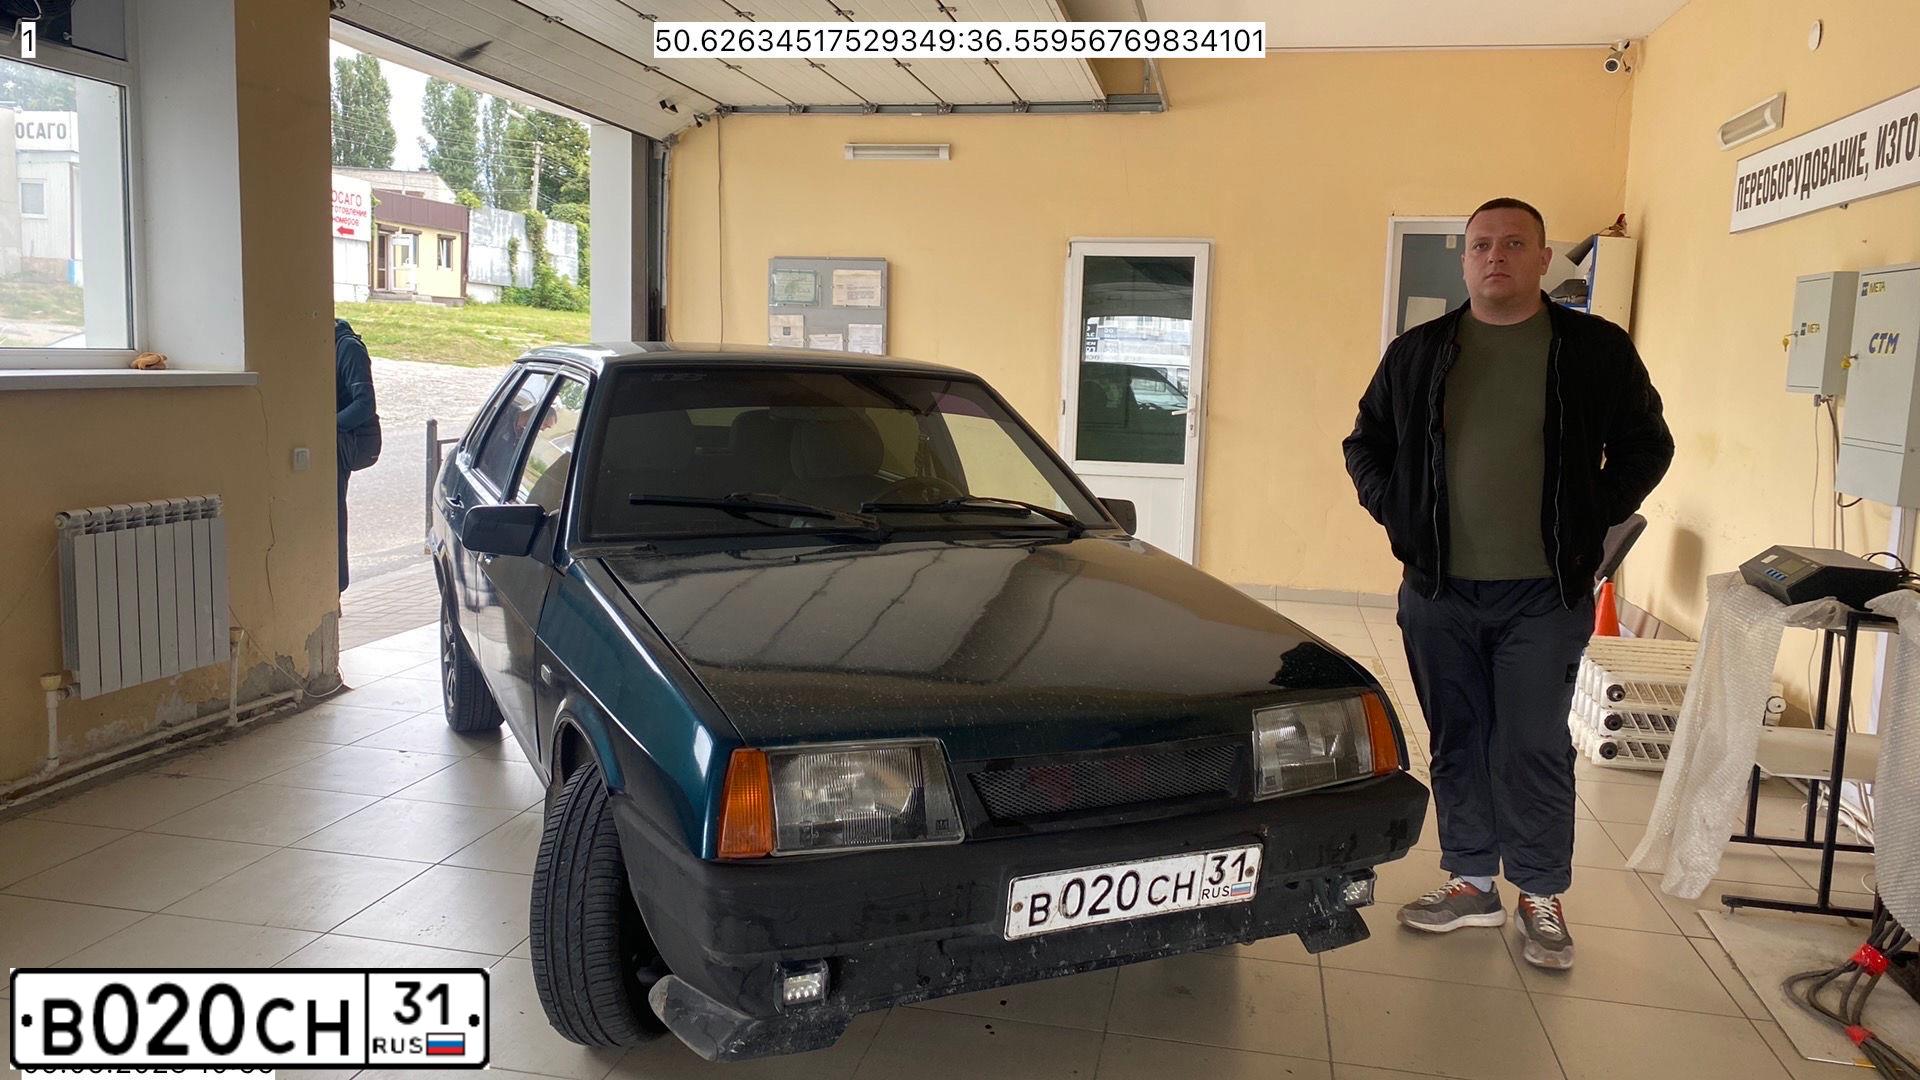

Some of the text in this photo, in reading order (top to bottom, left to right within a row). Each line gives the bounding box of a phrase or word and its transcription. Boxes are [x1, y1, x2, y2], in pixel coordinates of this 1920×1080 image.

[15, 122, 67, 140] ОСАГО
[1736, 112, 1920, 212] ПЕРЕОБОРУДОВАНИЕ, ИЗГО
[1208, 851, 1248, 886] 31
[1201, 885, 1230, 900] RUS
